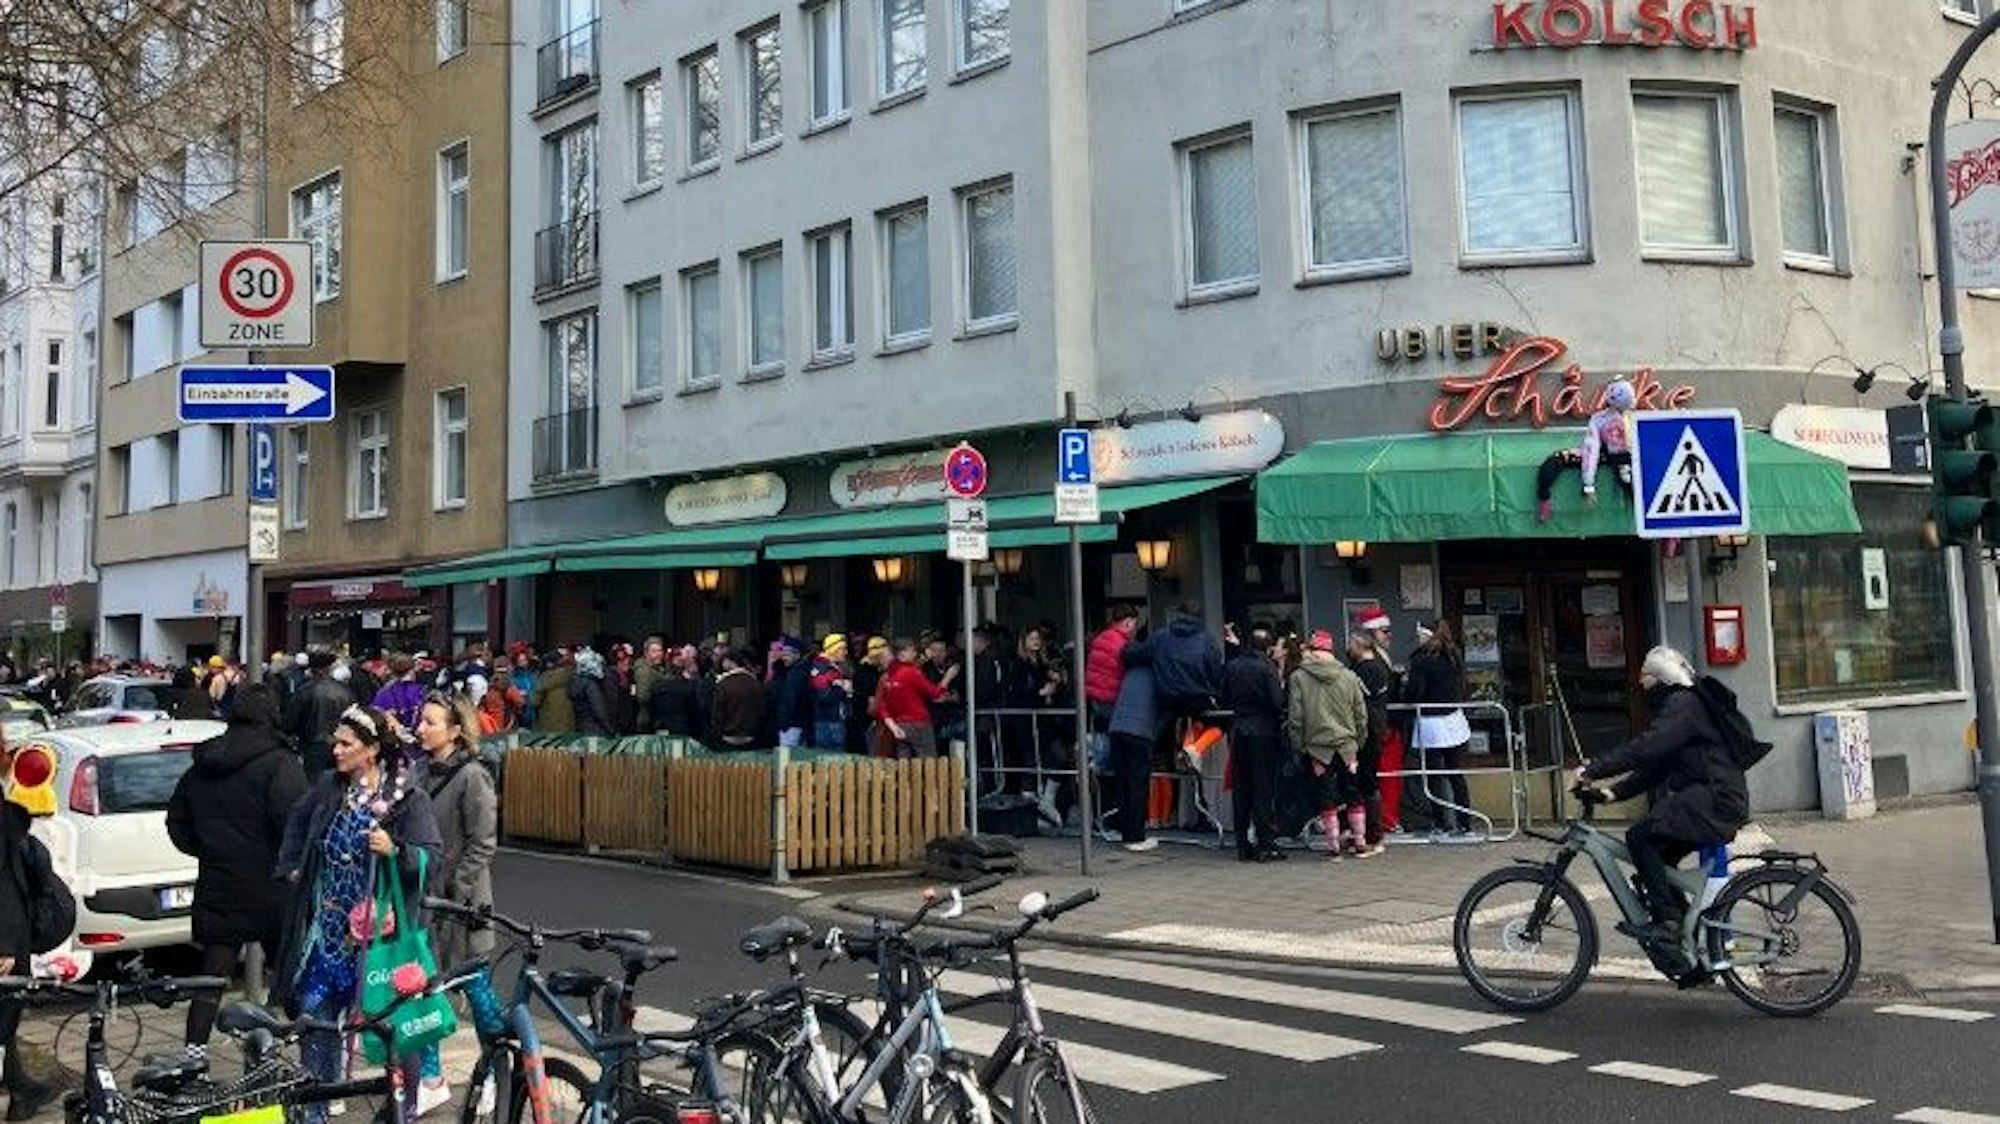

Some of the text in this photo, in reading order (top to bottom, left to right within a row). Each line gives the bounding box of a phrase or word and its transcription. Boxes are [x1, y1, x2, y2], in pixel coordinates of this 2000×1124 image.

[236, 268, 278, 299] 30
[229, 323, 285, 340] ZONE
[1377, 321, 1502, 361] UBIER
[187, 387, 290, 400] Einbahnstraße
[256, 431, 273, 490] P
[1066, 436, 1085, 469] P
